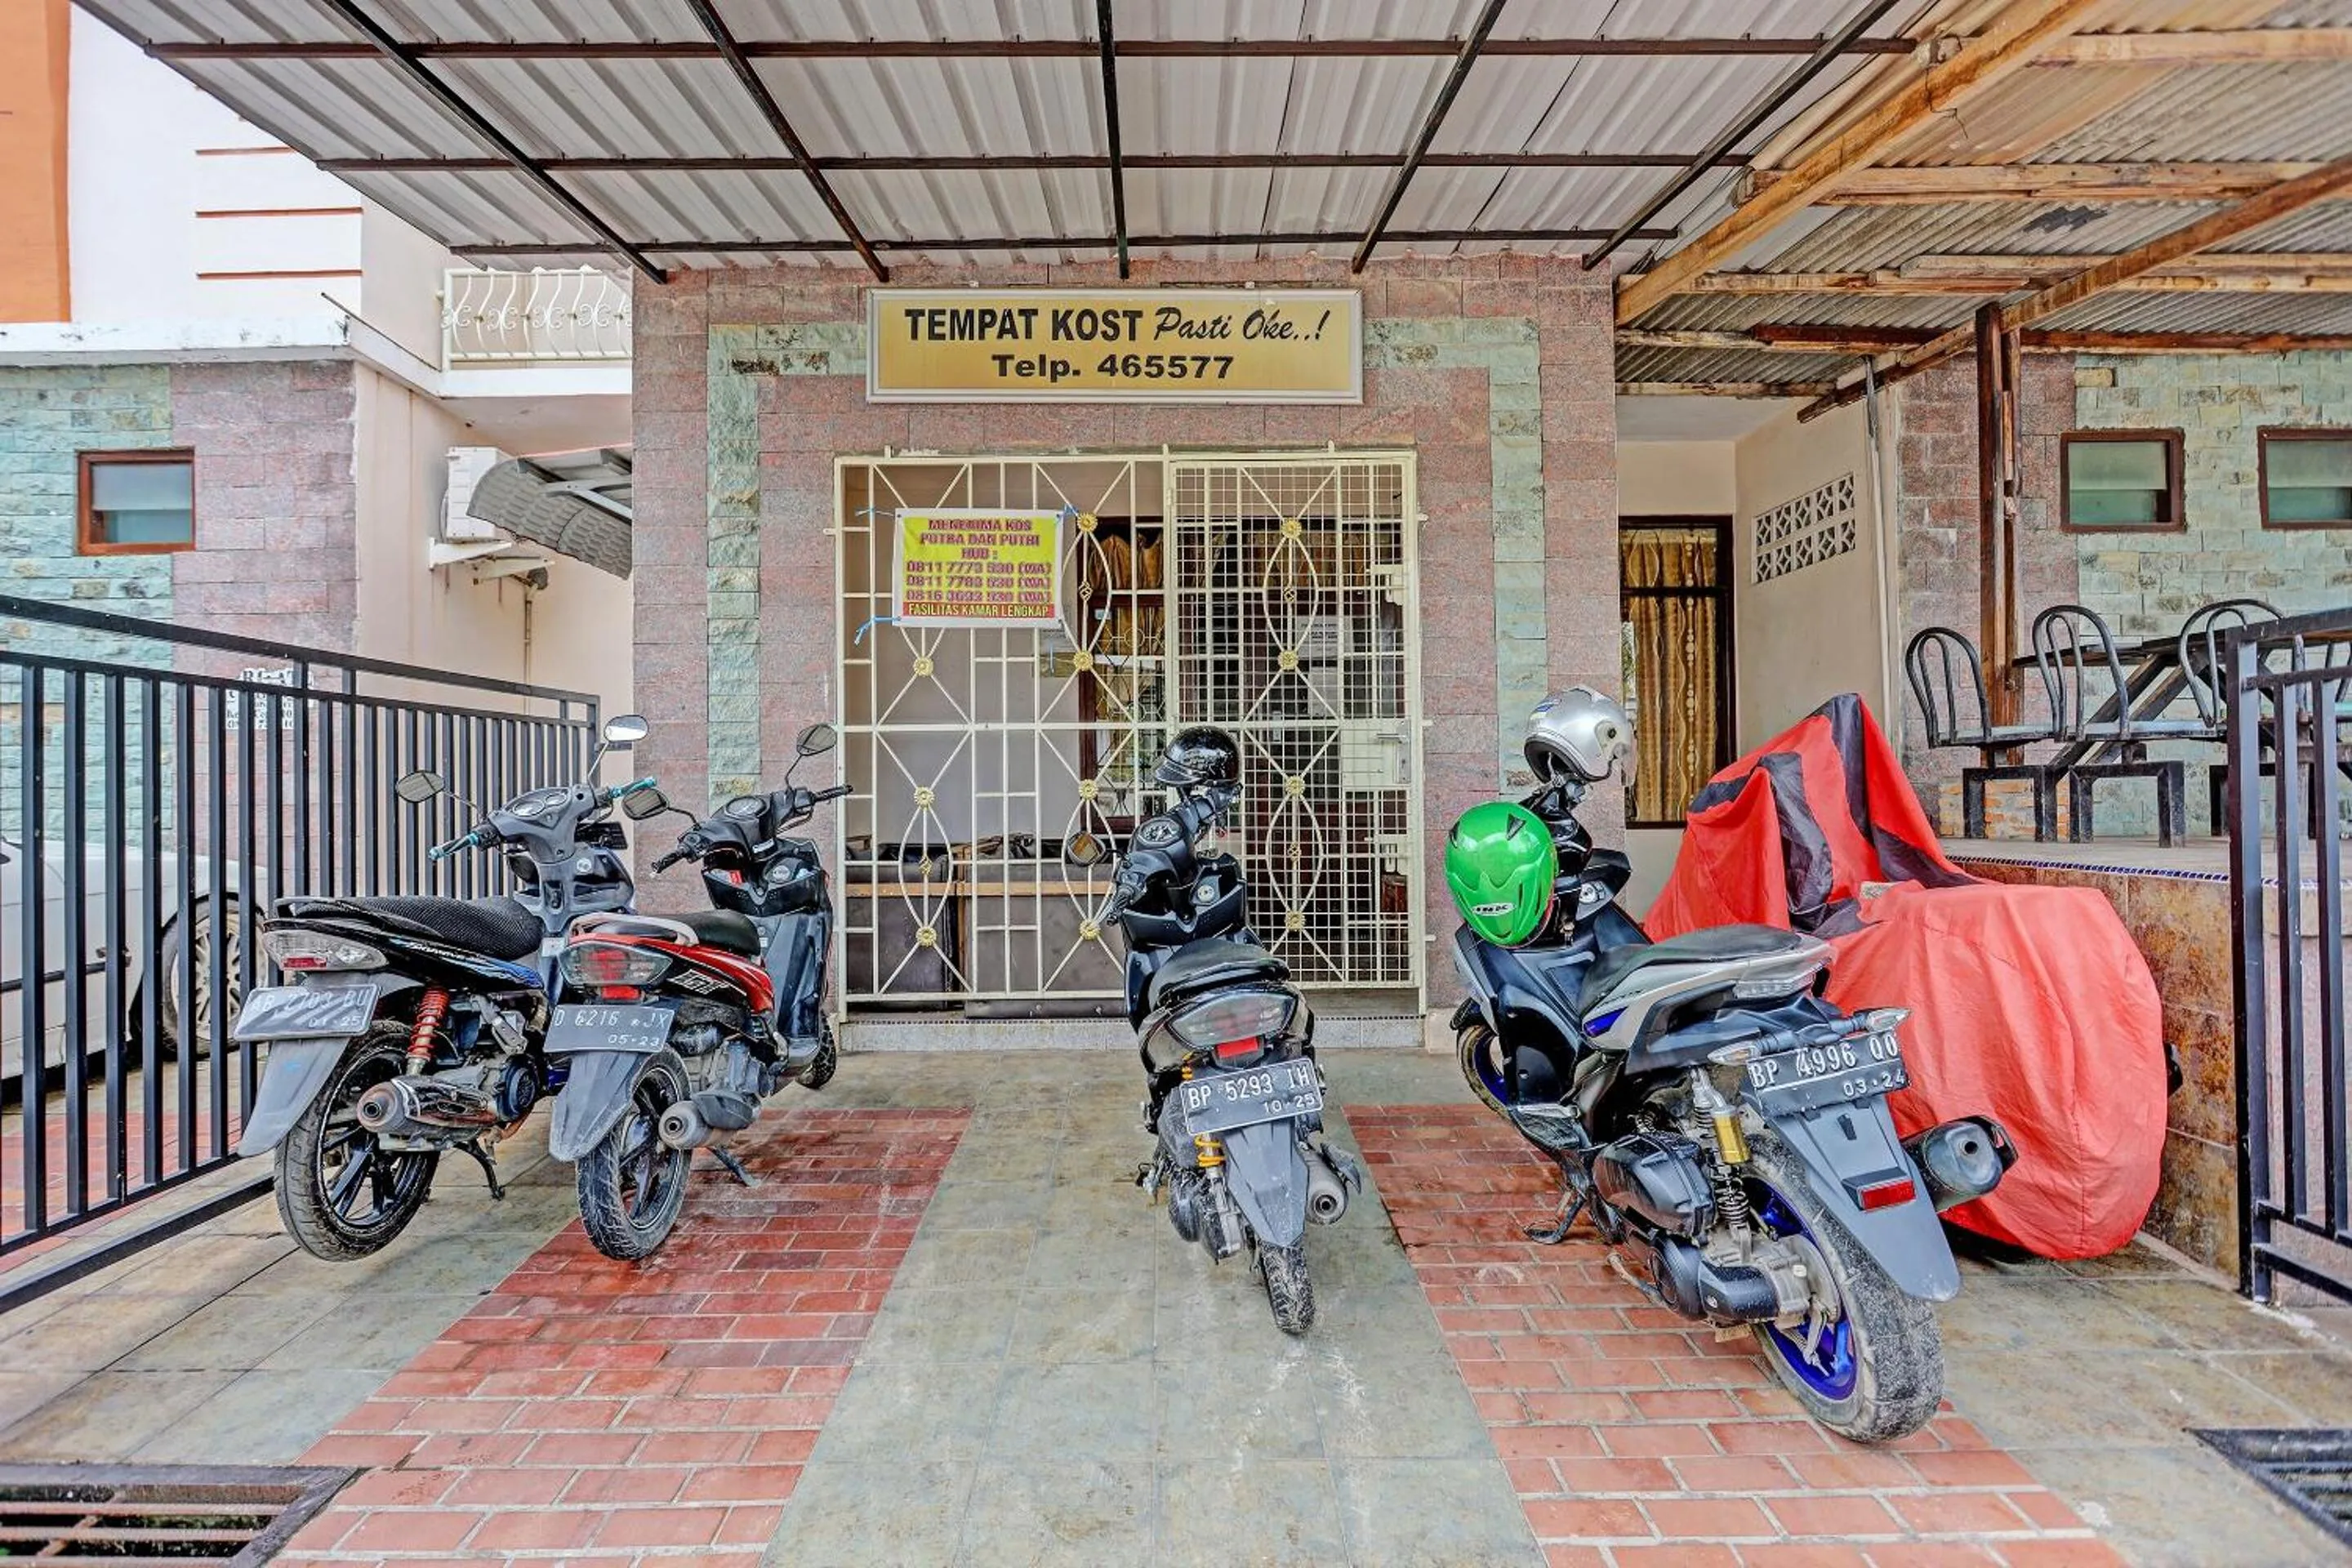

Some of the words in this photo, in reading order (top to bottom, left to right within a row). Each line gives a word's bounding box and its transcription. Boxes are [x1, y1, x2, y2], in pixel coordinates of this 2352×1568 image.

[904, 308, 1039, 341] TEMPAT
[1050, 308, 1144, 341] KOST
[1153, 306, 1232, 341] Pasti
[1241, 310, 1331, 341] Oke..!
[991, 354, 1080, 383] Telp.
[1096, 354, 1234, 381] 465577
[920, 532, 964, 545] PUTRA
[999, 533, 1040, 546] PUTRI
[908, 603, 960, 616] FASILITAS
[962, 604, 998, 617] KAMAR
[1001, 604, 1049, 617] LENGKAP
[1747, 1060, 1778, 1089] BP
[1187, 1085, 1212, 1109] BP
[1225, 1072, 1274, 1102] 5293
